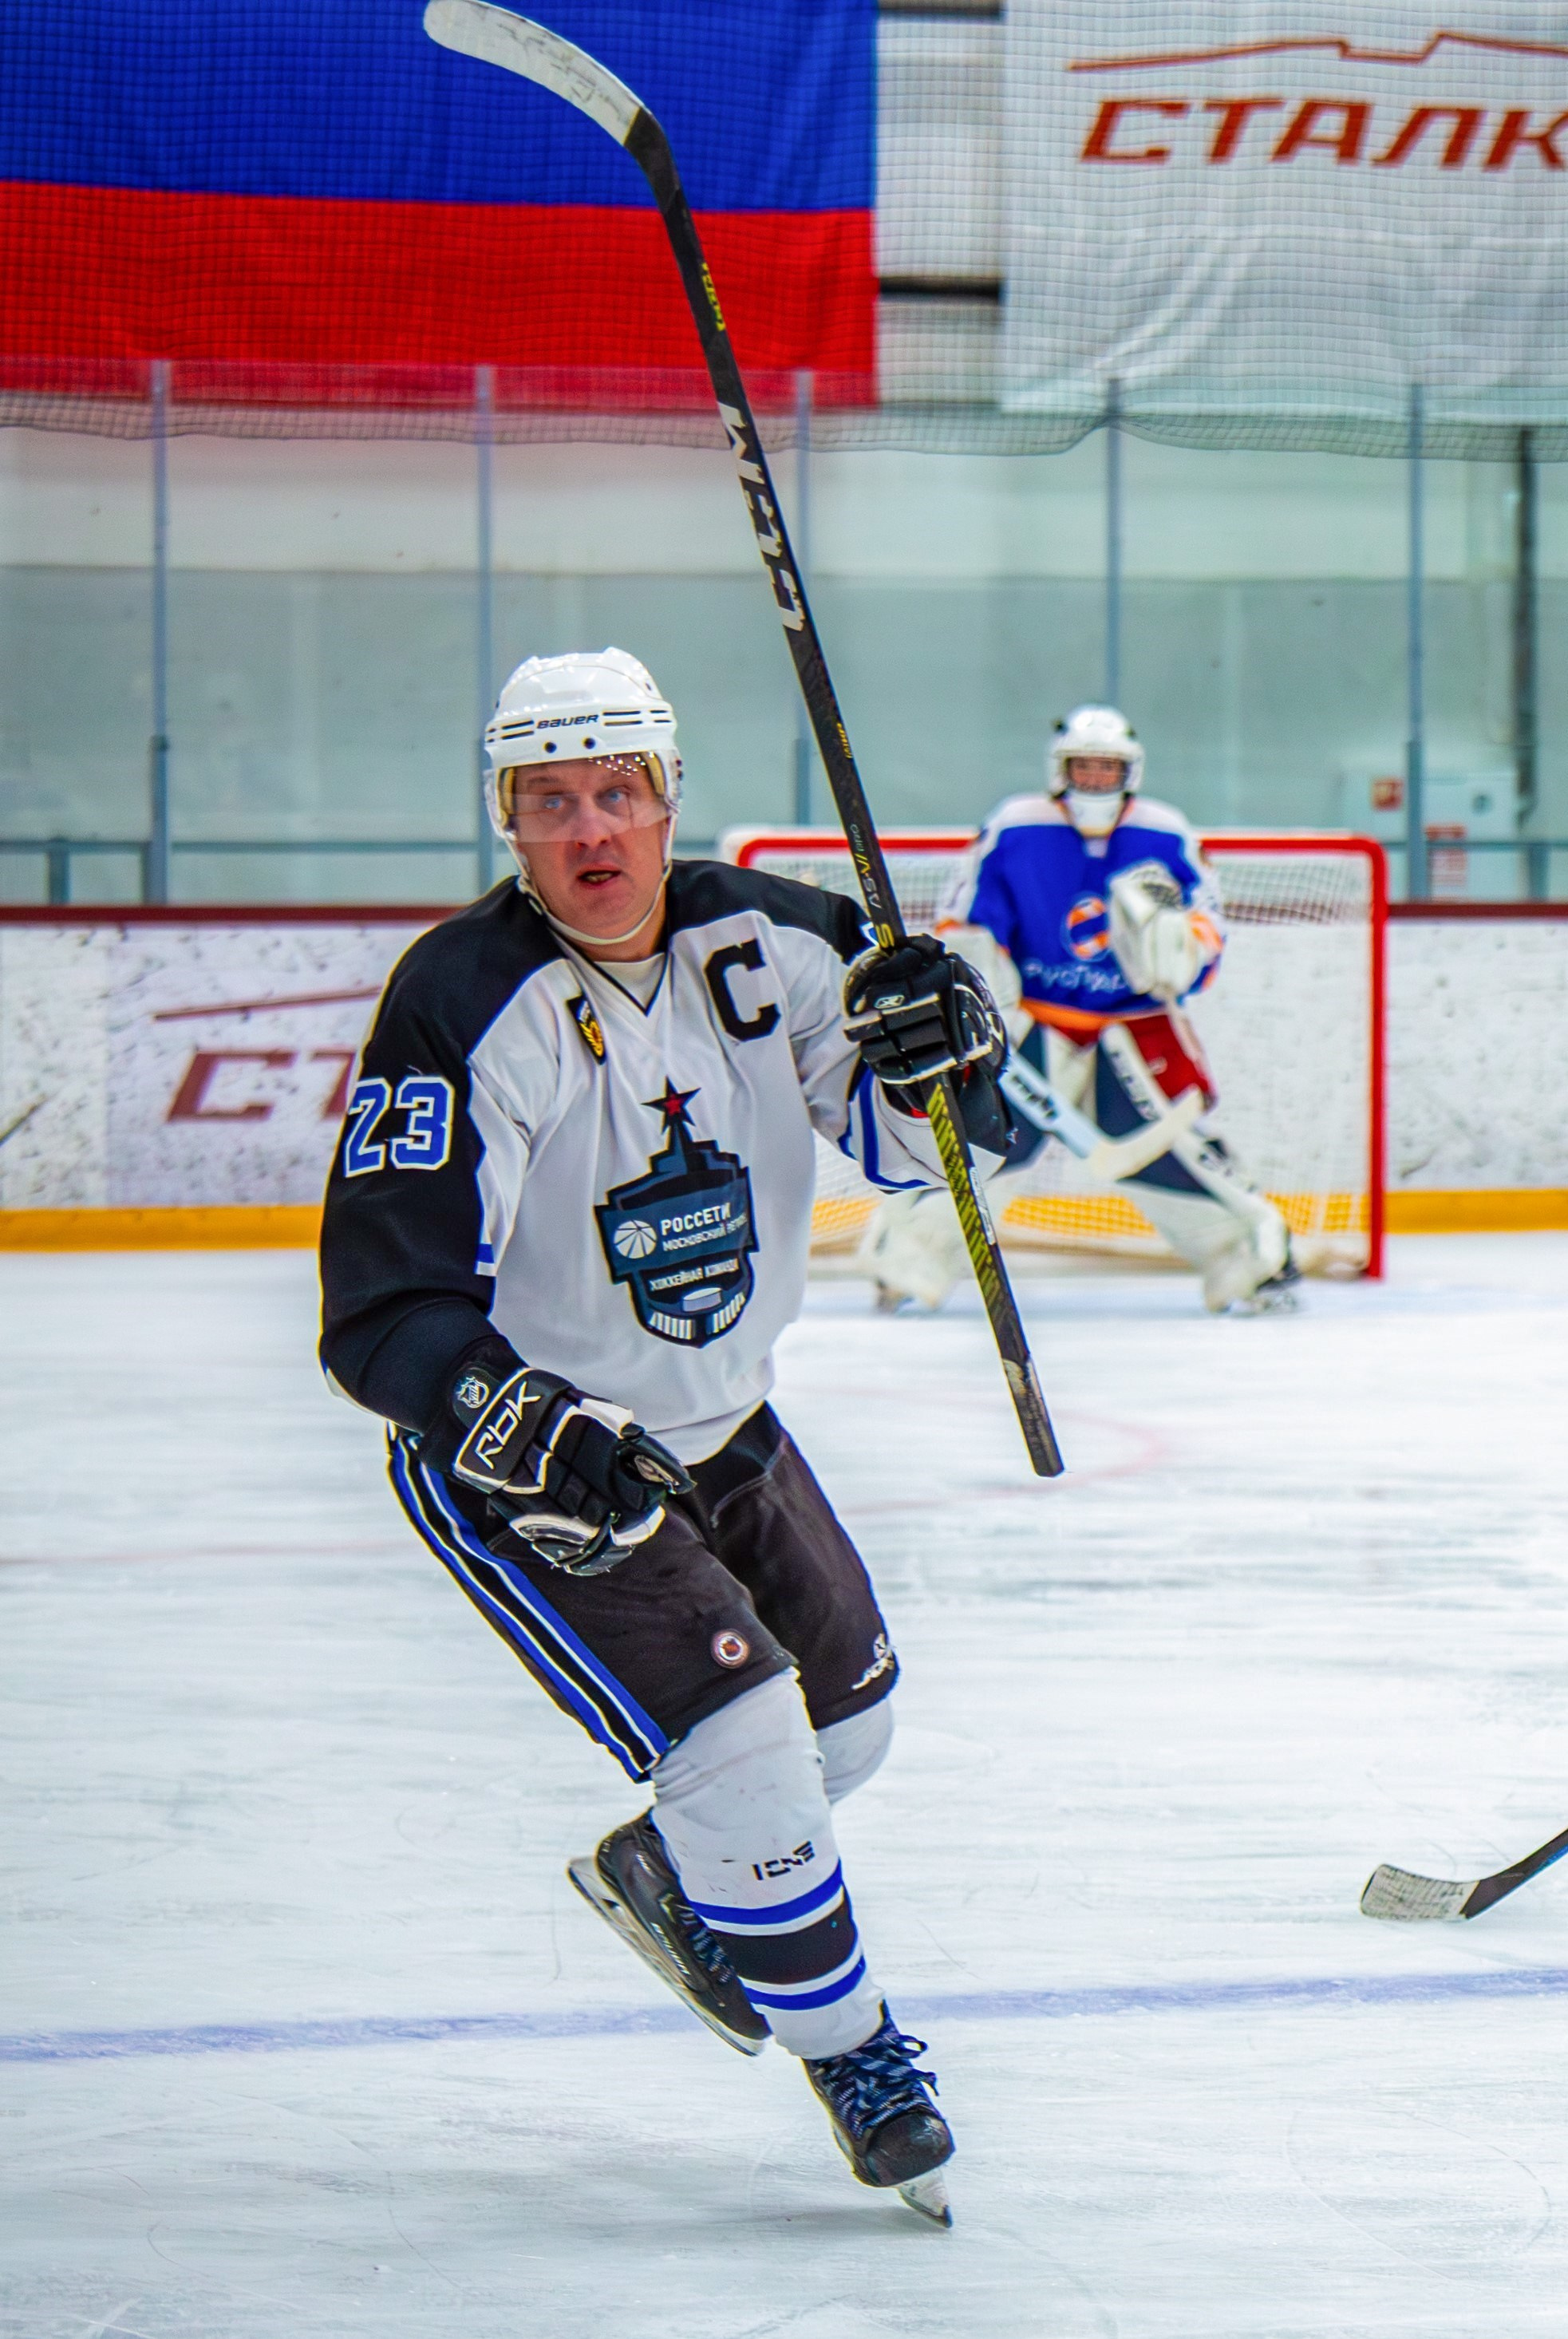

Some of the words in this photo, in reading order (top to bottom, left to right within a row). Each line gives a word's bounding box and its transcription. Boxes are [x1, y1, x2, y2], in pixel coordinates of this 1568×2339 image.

[1080, 96, 1568, 171] СТАЛК
[717, 401, 805, 631] CCM
[536, 714, 599, 729] BAUER
[703, 938, 782, 1042] C
[346, 1077, 455, 1178] 23
[660, 1202, 730, 1236] РОССЕТИ
